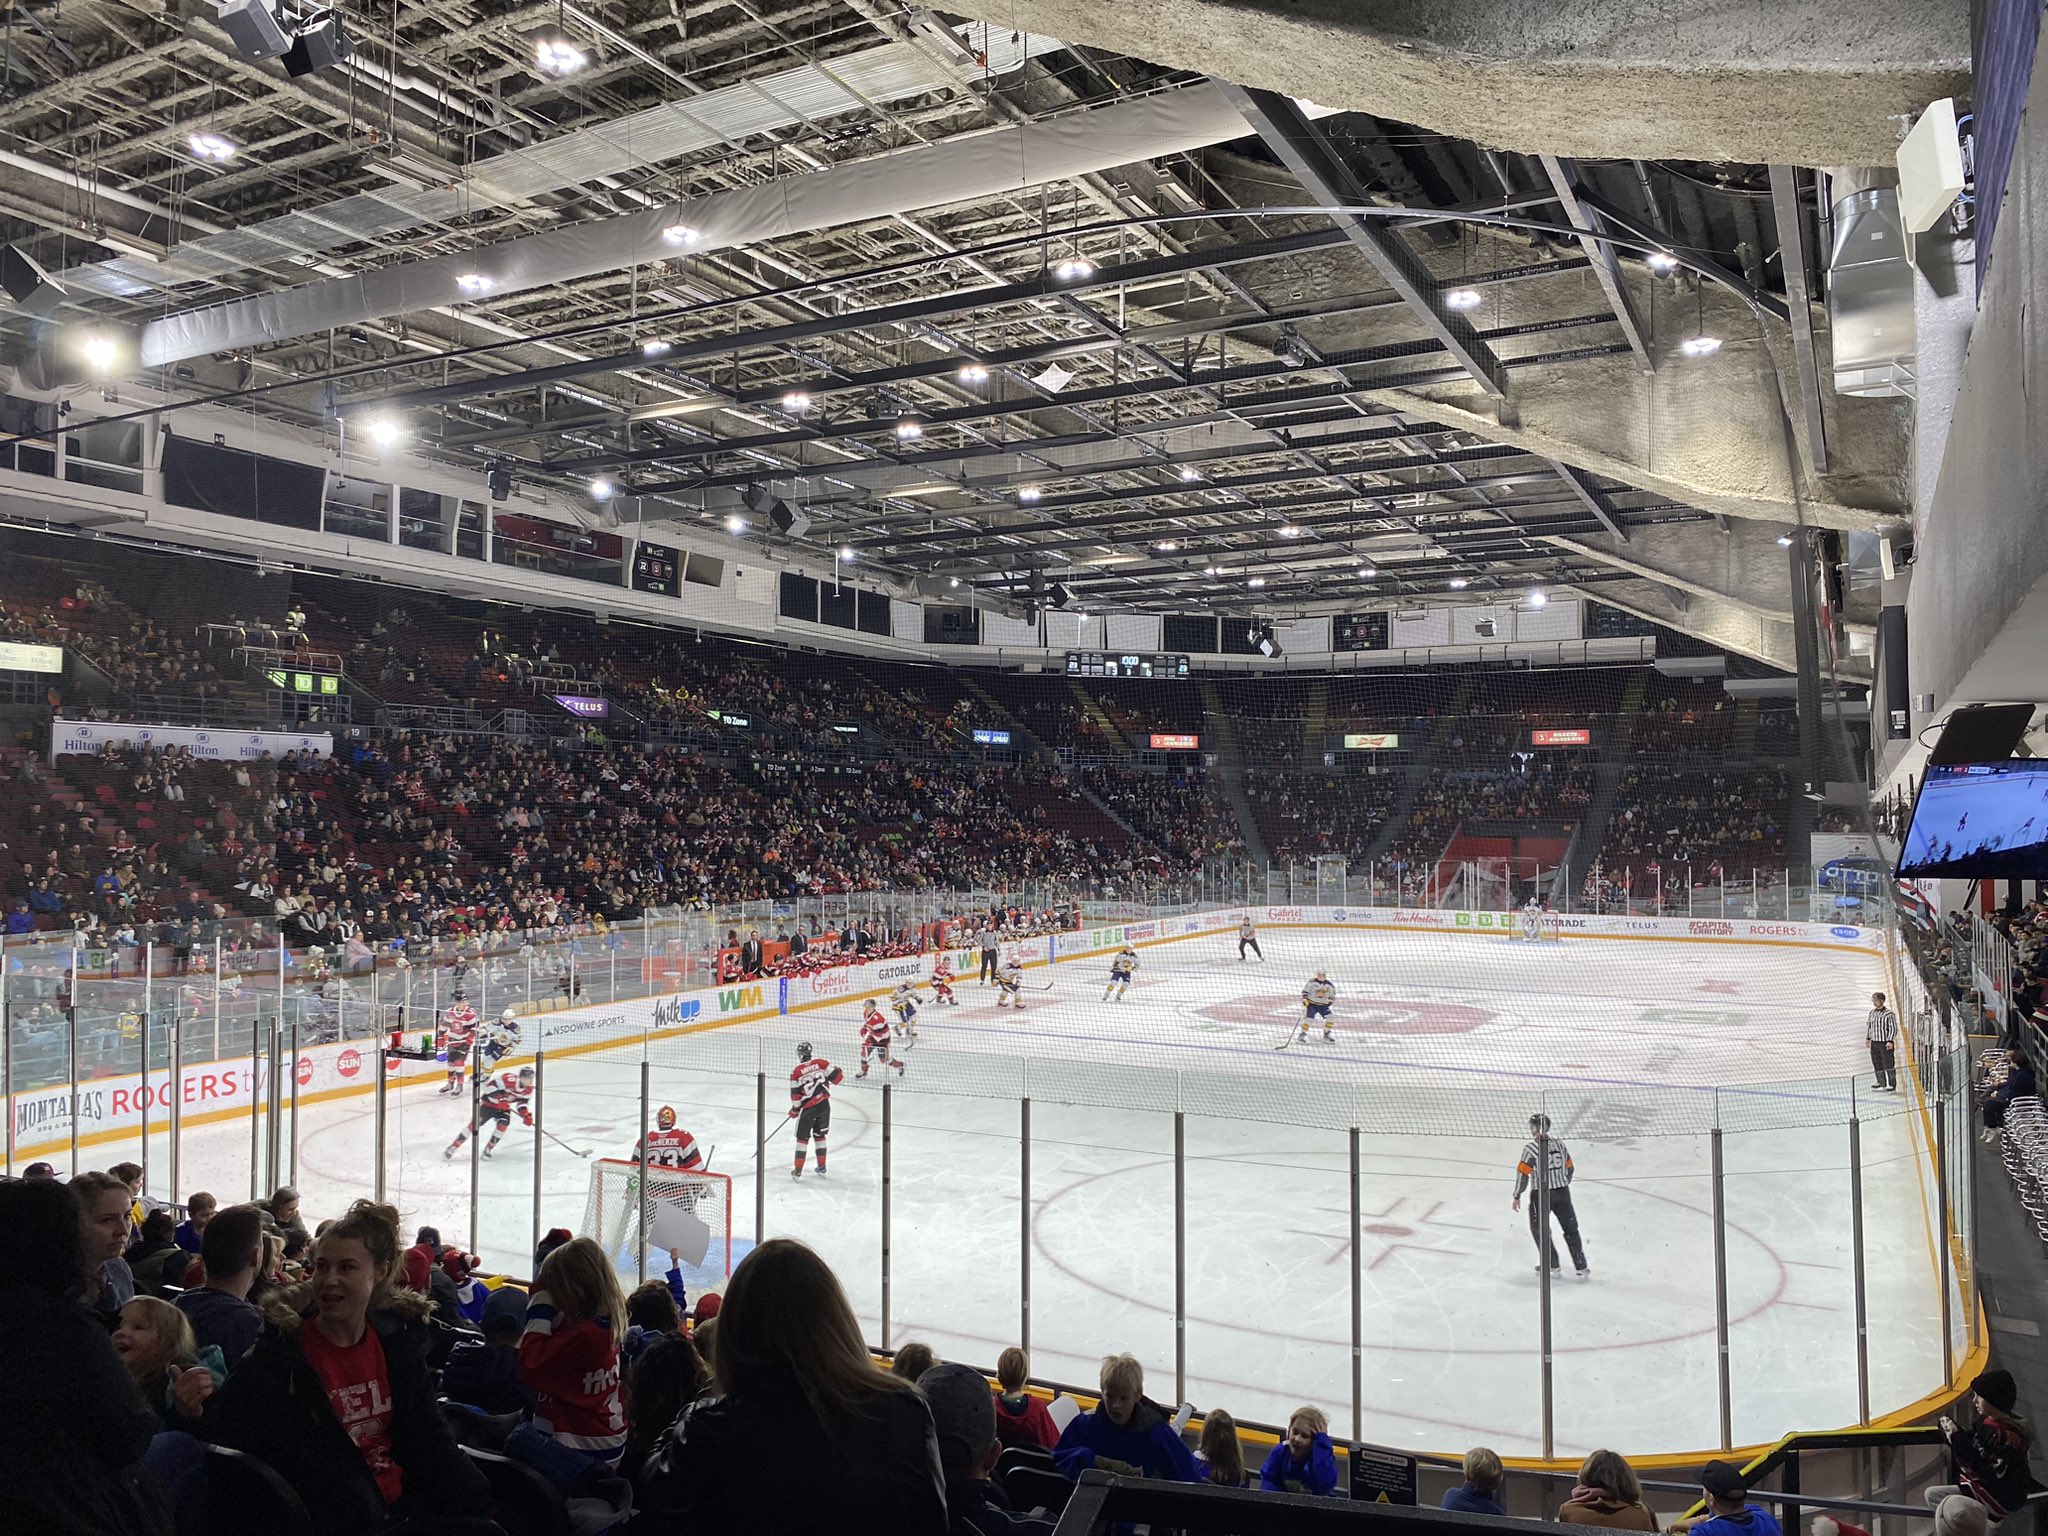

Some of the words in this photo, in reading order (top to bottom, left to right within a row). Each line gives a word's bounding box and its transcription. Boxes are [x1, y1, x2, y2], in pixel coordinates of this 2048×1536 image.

[574, 702, 603, 712] TELUS
[732, 716, 748, 726] Zone
[351, 728, 360, 736] 19
[65, 740, 102, 751] Hilton
[240, 746, 267, 757] Hilto
[1268, 908, 1303, 919] Gabriel
[1410, 913, 1443, 924] Hortons
[1626, 921, 1658, 929] TELUS
[1688, 921, 1733, 930] #CAPITAL
[1750, 925, 1797, 936] ROGERS
[1688, 928, 1733, 936] TERRITORY
[879, 963, 921, 980] GATORADE
[812, 970, 849, 994] Gabriel
[718, 986, 763, 1012] WM
[597, 1016, 625, 1028] SPORTS
[338, 1057, 360, 1070] SUN
[800, 1072, 826, 1097] 22
